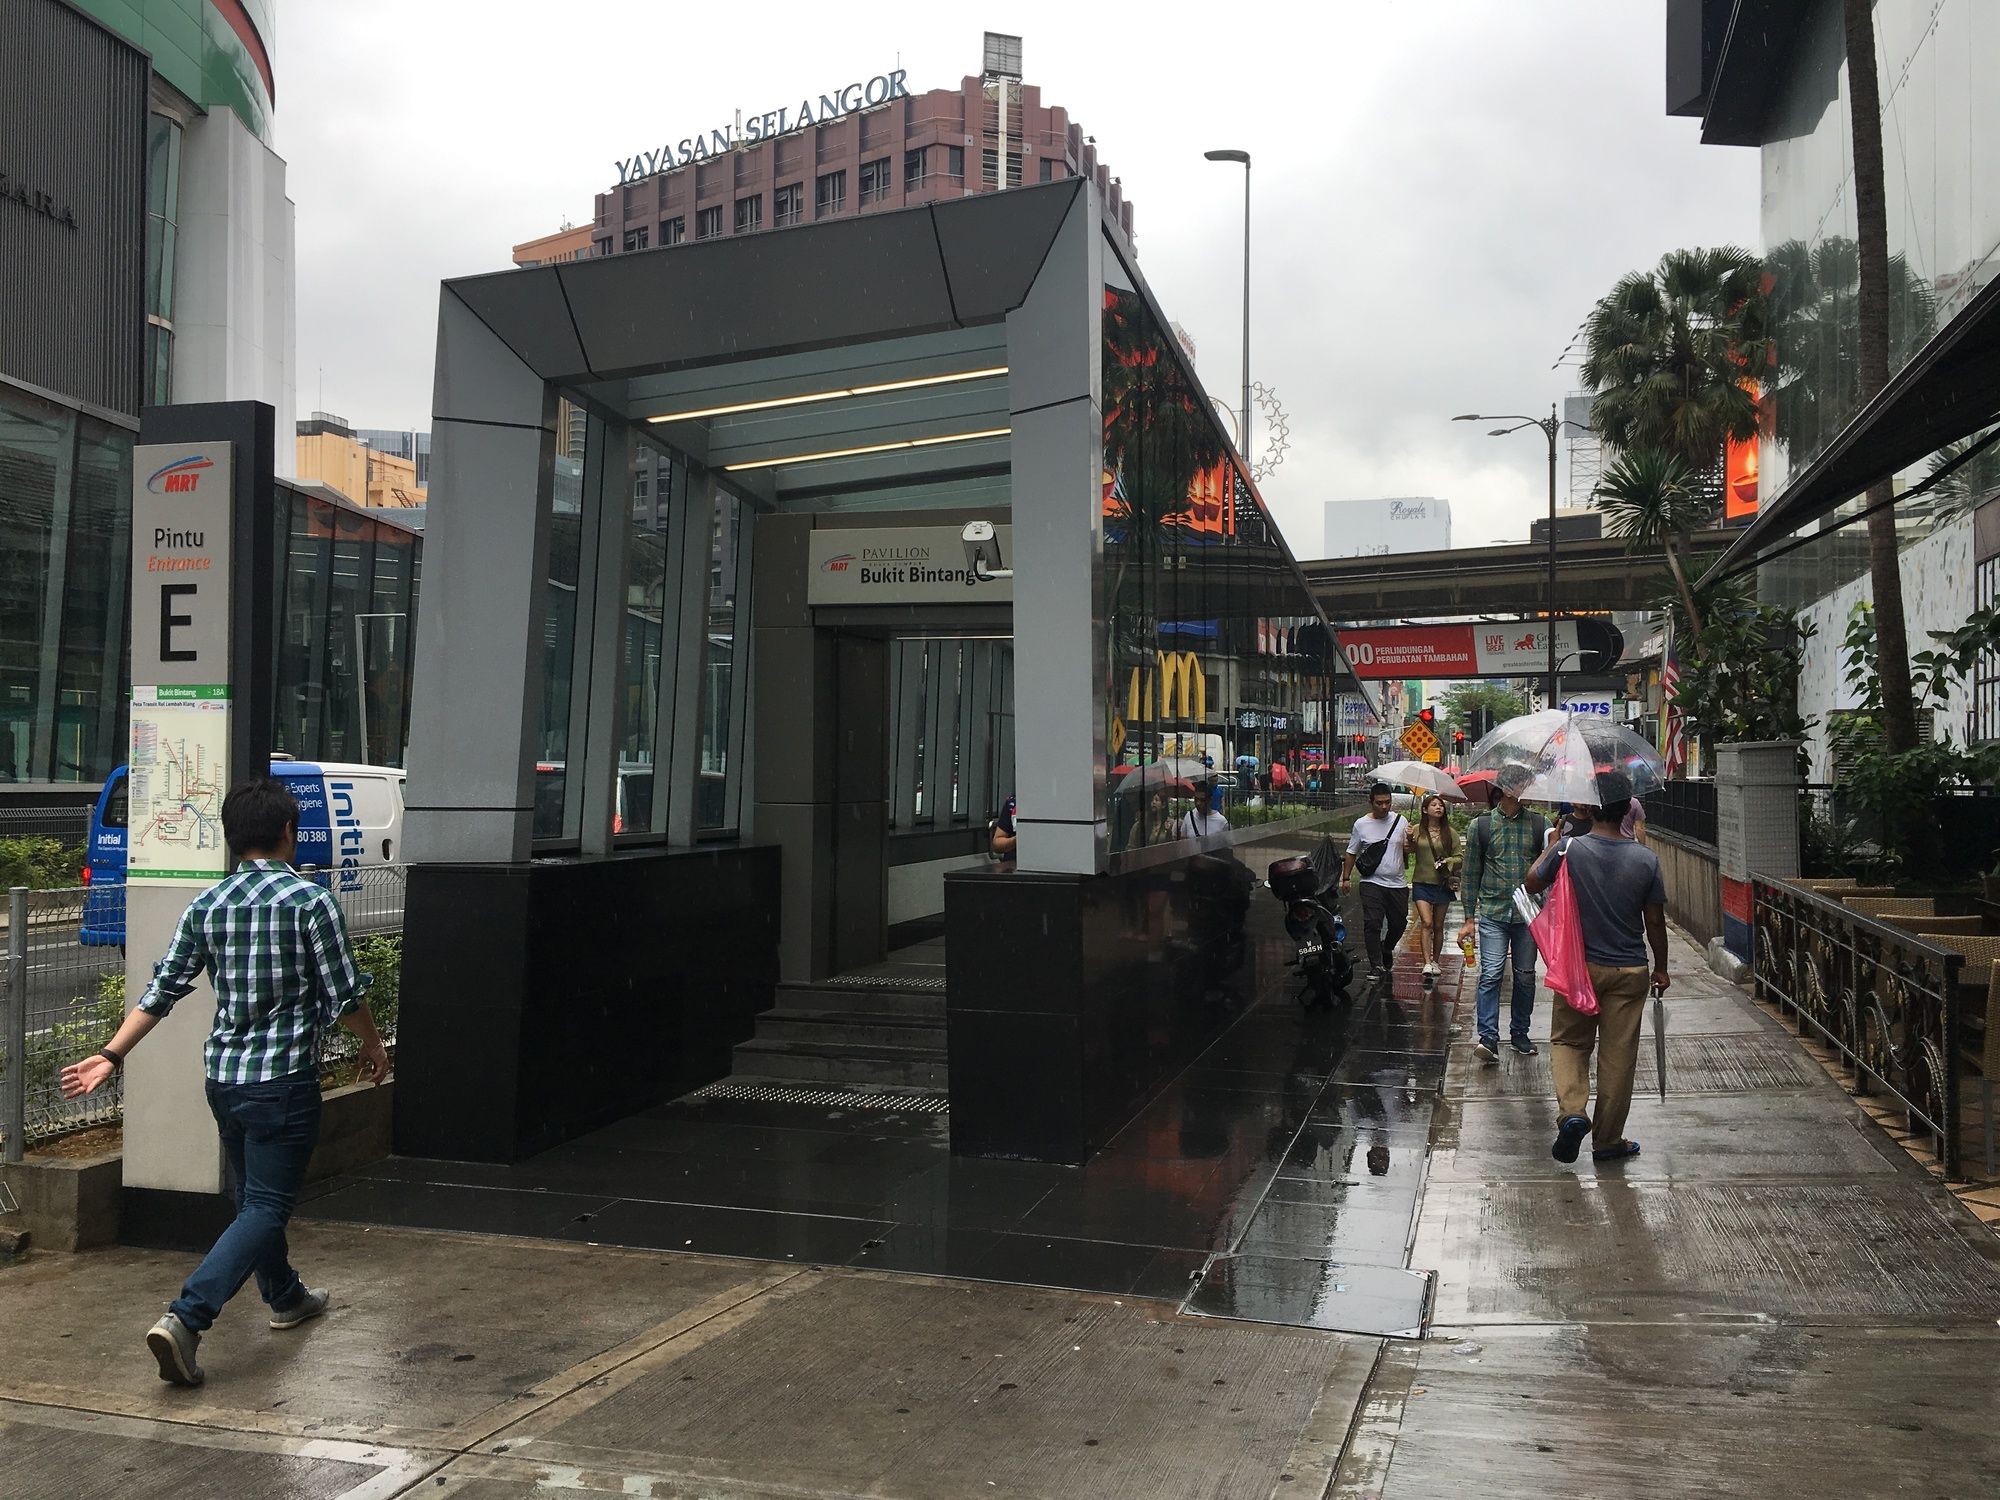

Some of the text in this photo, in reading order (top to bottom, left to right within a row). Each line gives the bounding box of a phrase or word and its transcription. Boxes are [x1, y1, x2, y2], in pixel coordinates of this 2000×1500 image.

[614, 69, 911, 185] YAYASAN SELANGOR
[165, 474, 199, 493] MRT
[154, 528, 204, 548] Pintu
[863, 547, 930, 560] PAVILION
[147, 556, 211, 572] Entrance
[830, 563, 849, 572] MRT
[861, 567, 976, 586] Bukit Bintang
[160, 583, 197, 662] E
[1485, 635, 1504, 645] LIVE
[1345, 642, 1434, 665] 00 PERLINDUNGAN
[1376, 653, 1468, 664] PERUBATAN TAMBAHAN
[291, 782, 320, 795] Experts
[98, 833, 121, 845] Initial
[310, 830, 327, 841] 388
